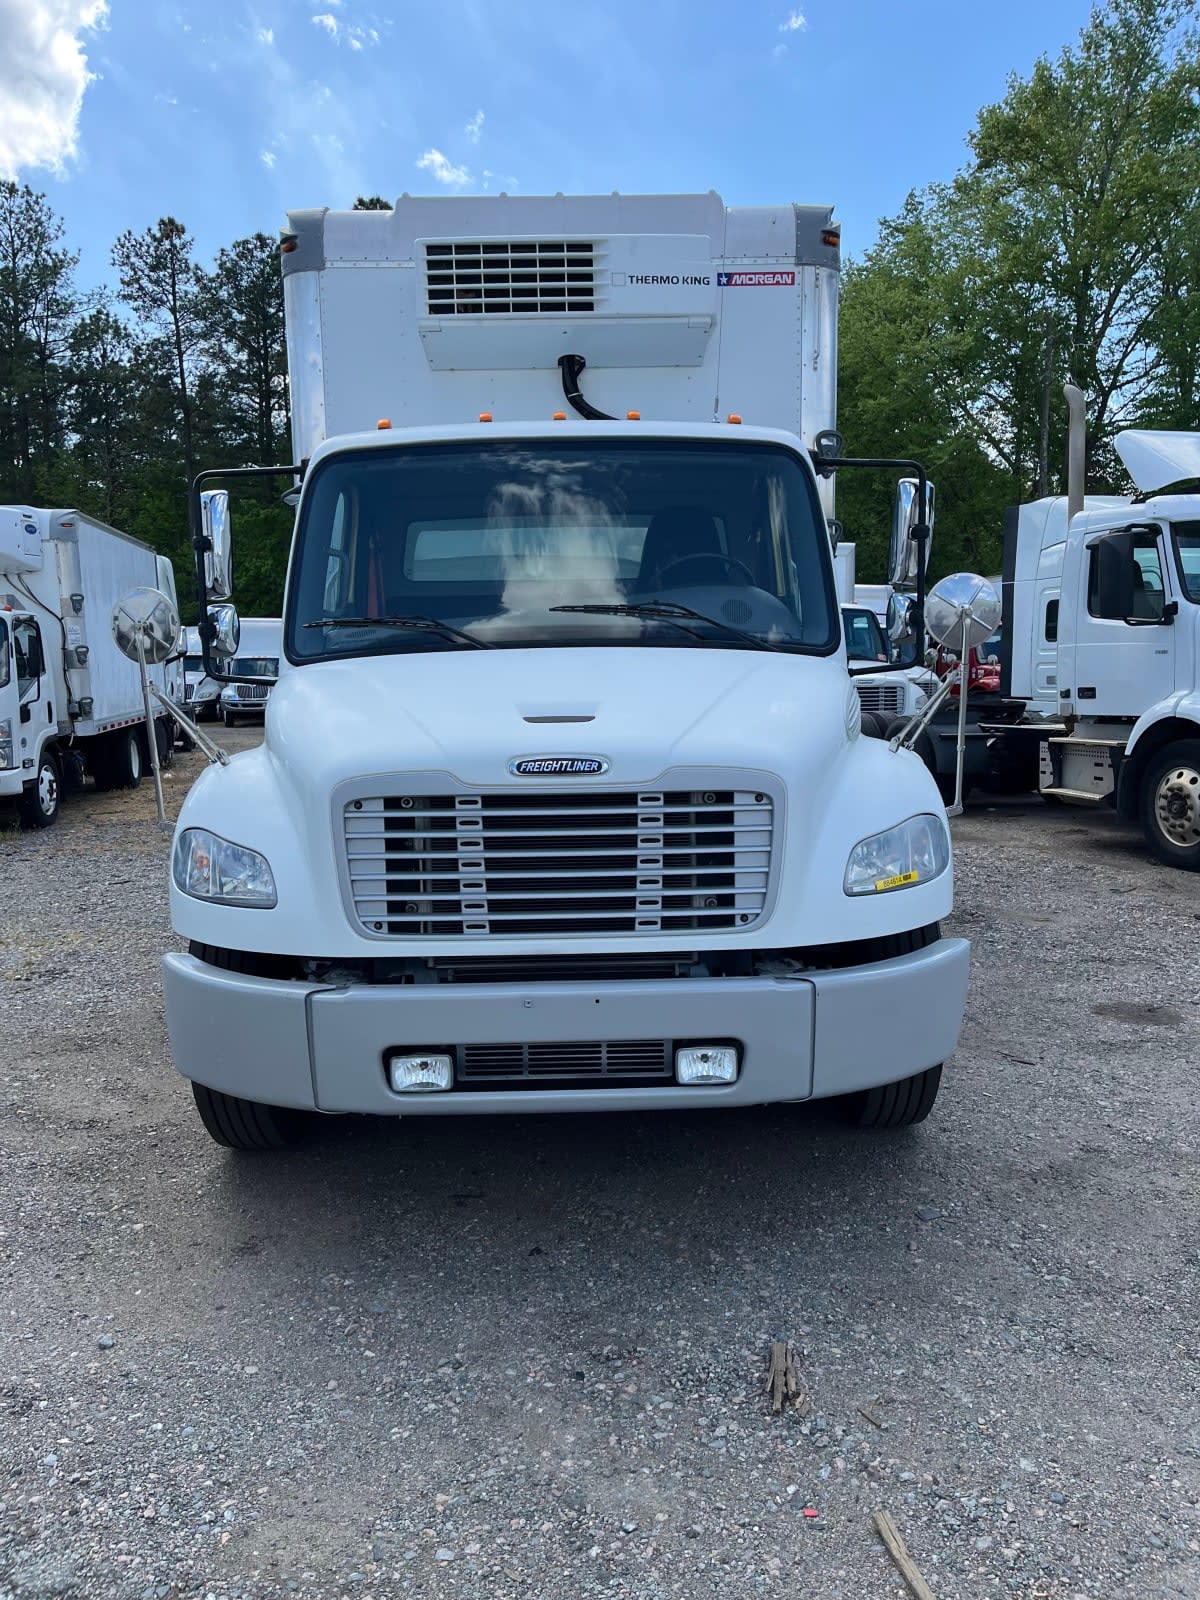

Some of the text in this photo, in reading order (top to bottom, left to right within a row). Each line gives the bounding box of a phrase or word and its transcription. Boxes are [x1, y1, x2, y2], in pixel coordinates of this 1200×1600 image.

[628, 275, 710, 286] THERMO KING
[731, 274, 792, 285] MORGAN
[519, 760, 599, 772] FREIGHTLINER
